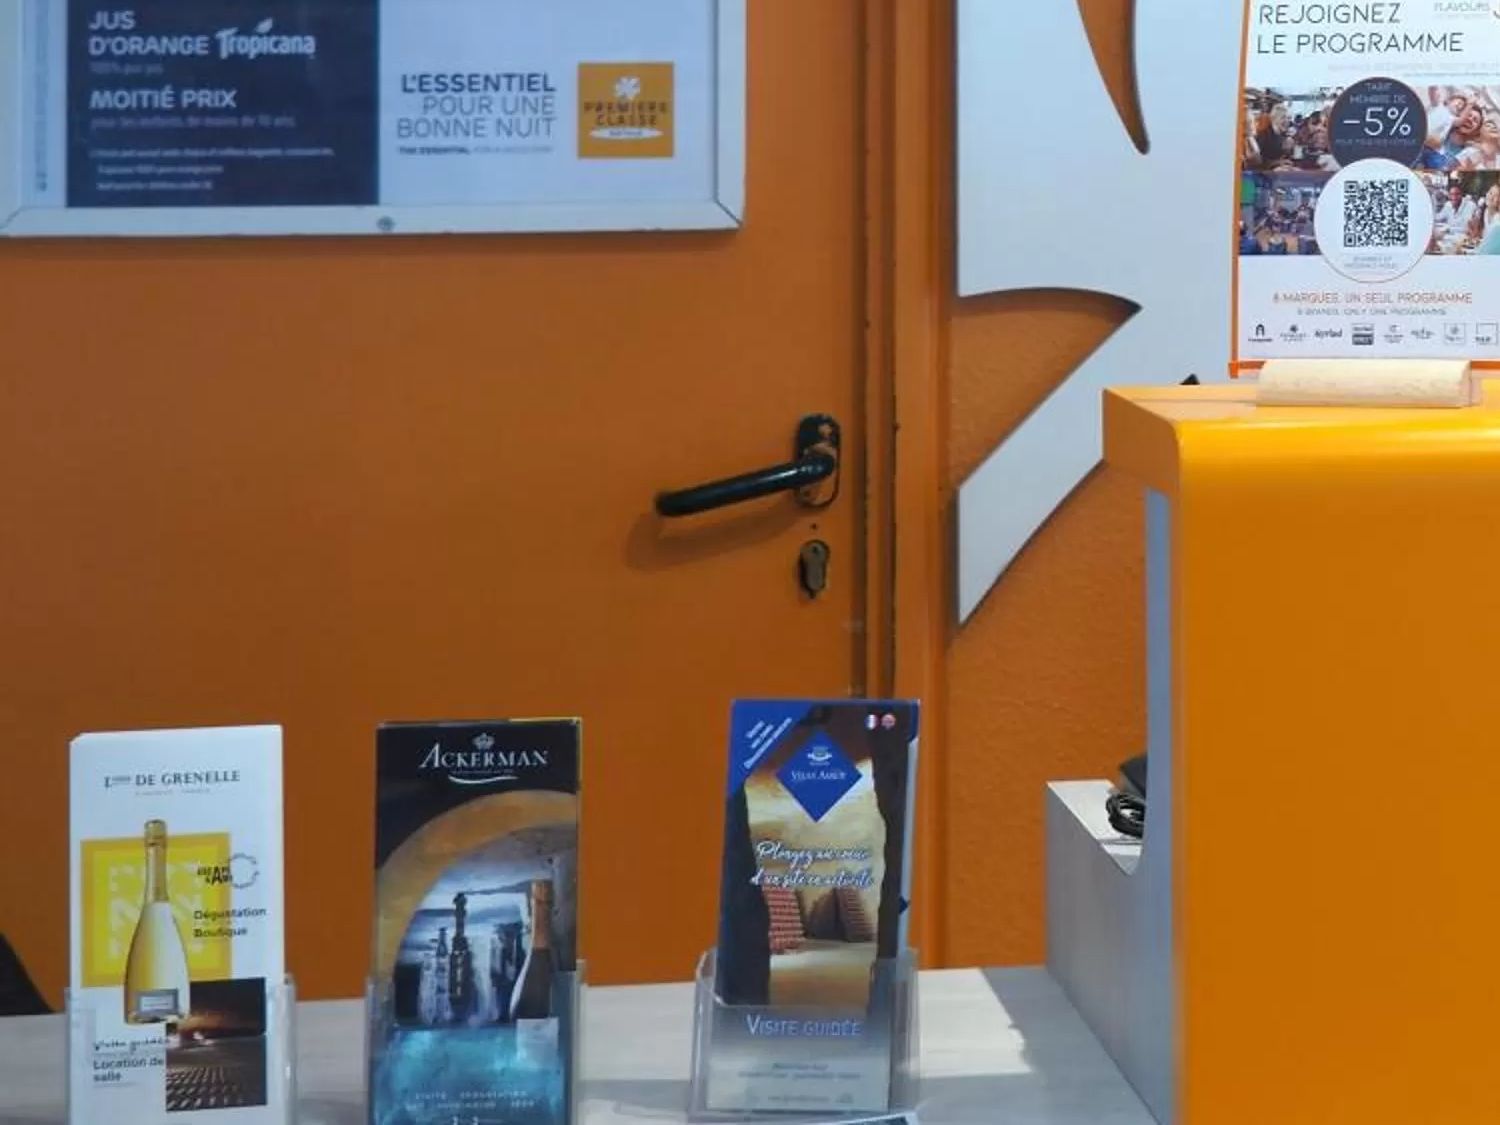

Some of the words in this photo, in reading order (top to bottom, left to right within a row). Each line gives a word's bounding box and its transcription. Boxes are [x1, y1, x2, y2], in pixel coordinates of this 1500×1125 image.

[88, 10, 136, 30] JUS
[1259, 2, 1401, 25] REJOIGNEZ
[88, 35, 209, 56] D'ORANGE
[215, 22, 316, 59] Tropicana
[1257, 35, 1287, 54] LE
[1296, 32, 1464, 54] PROGRAMME
[402, 73, 556, 93] L'ESSENTIEL
[89, 85, 175, 109] MOITIÉ
[181, 90, 237, 108] PRIX
[423, 95, 493, 116] POUR
[501, 94, 555, 115] UNE
[396, 117, 485, 138] BONNE
[496, 116, 556, 137] NUIT
[1343, 106, 1412, 137] -5%
[1398, 292, 1473, 304] PROGRAMME
[419, 742, 548, 768] ACKERMAN
[135, 774, 157, 786] DE
[161, 770, 240, 785] GRENELLE
[194, 907, 266, 921] Dégustation
[194, 927, 248, 940] Boutique
[93, 1058, 146, 1070] Location
[150, 1057, 164, 1067] de
[94, 1071, 121, 1082] salle
